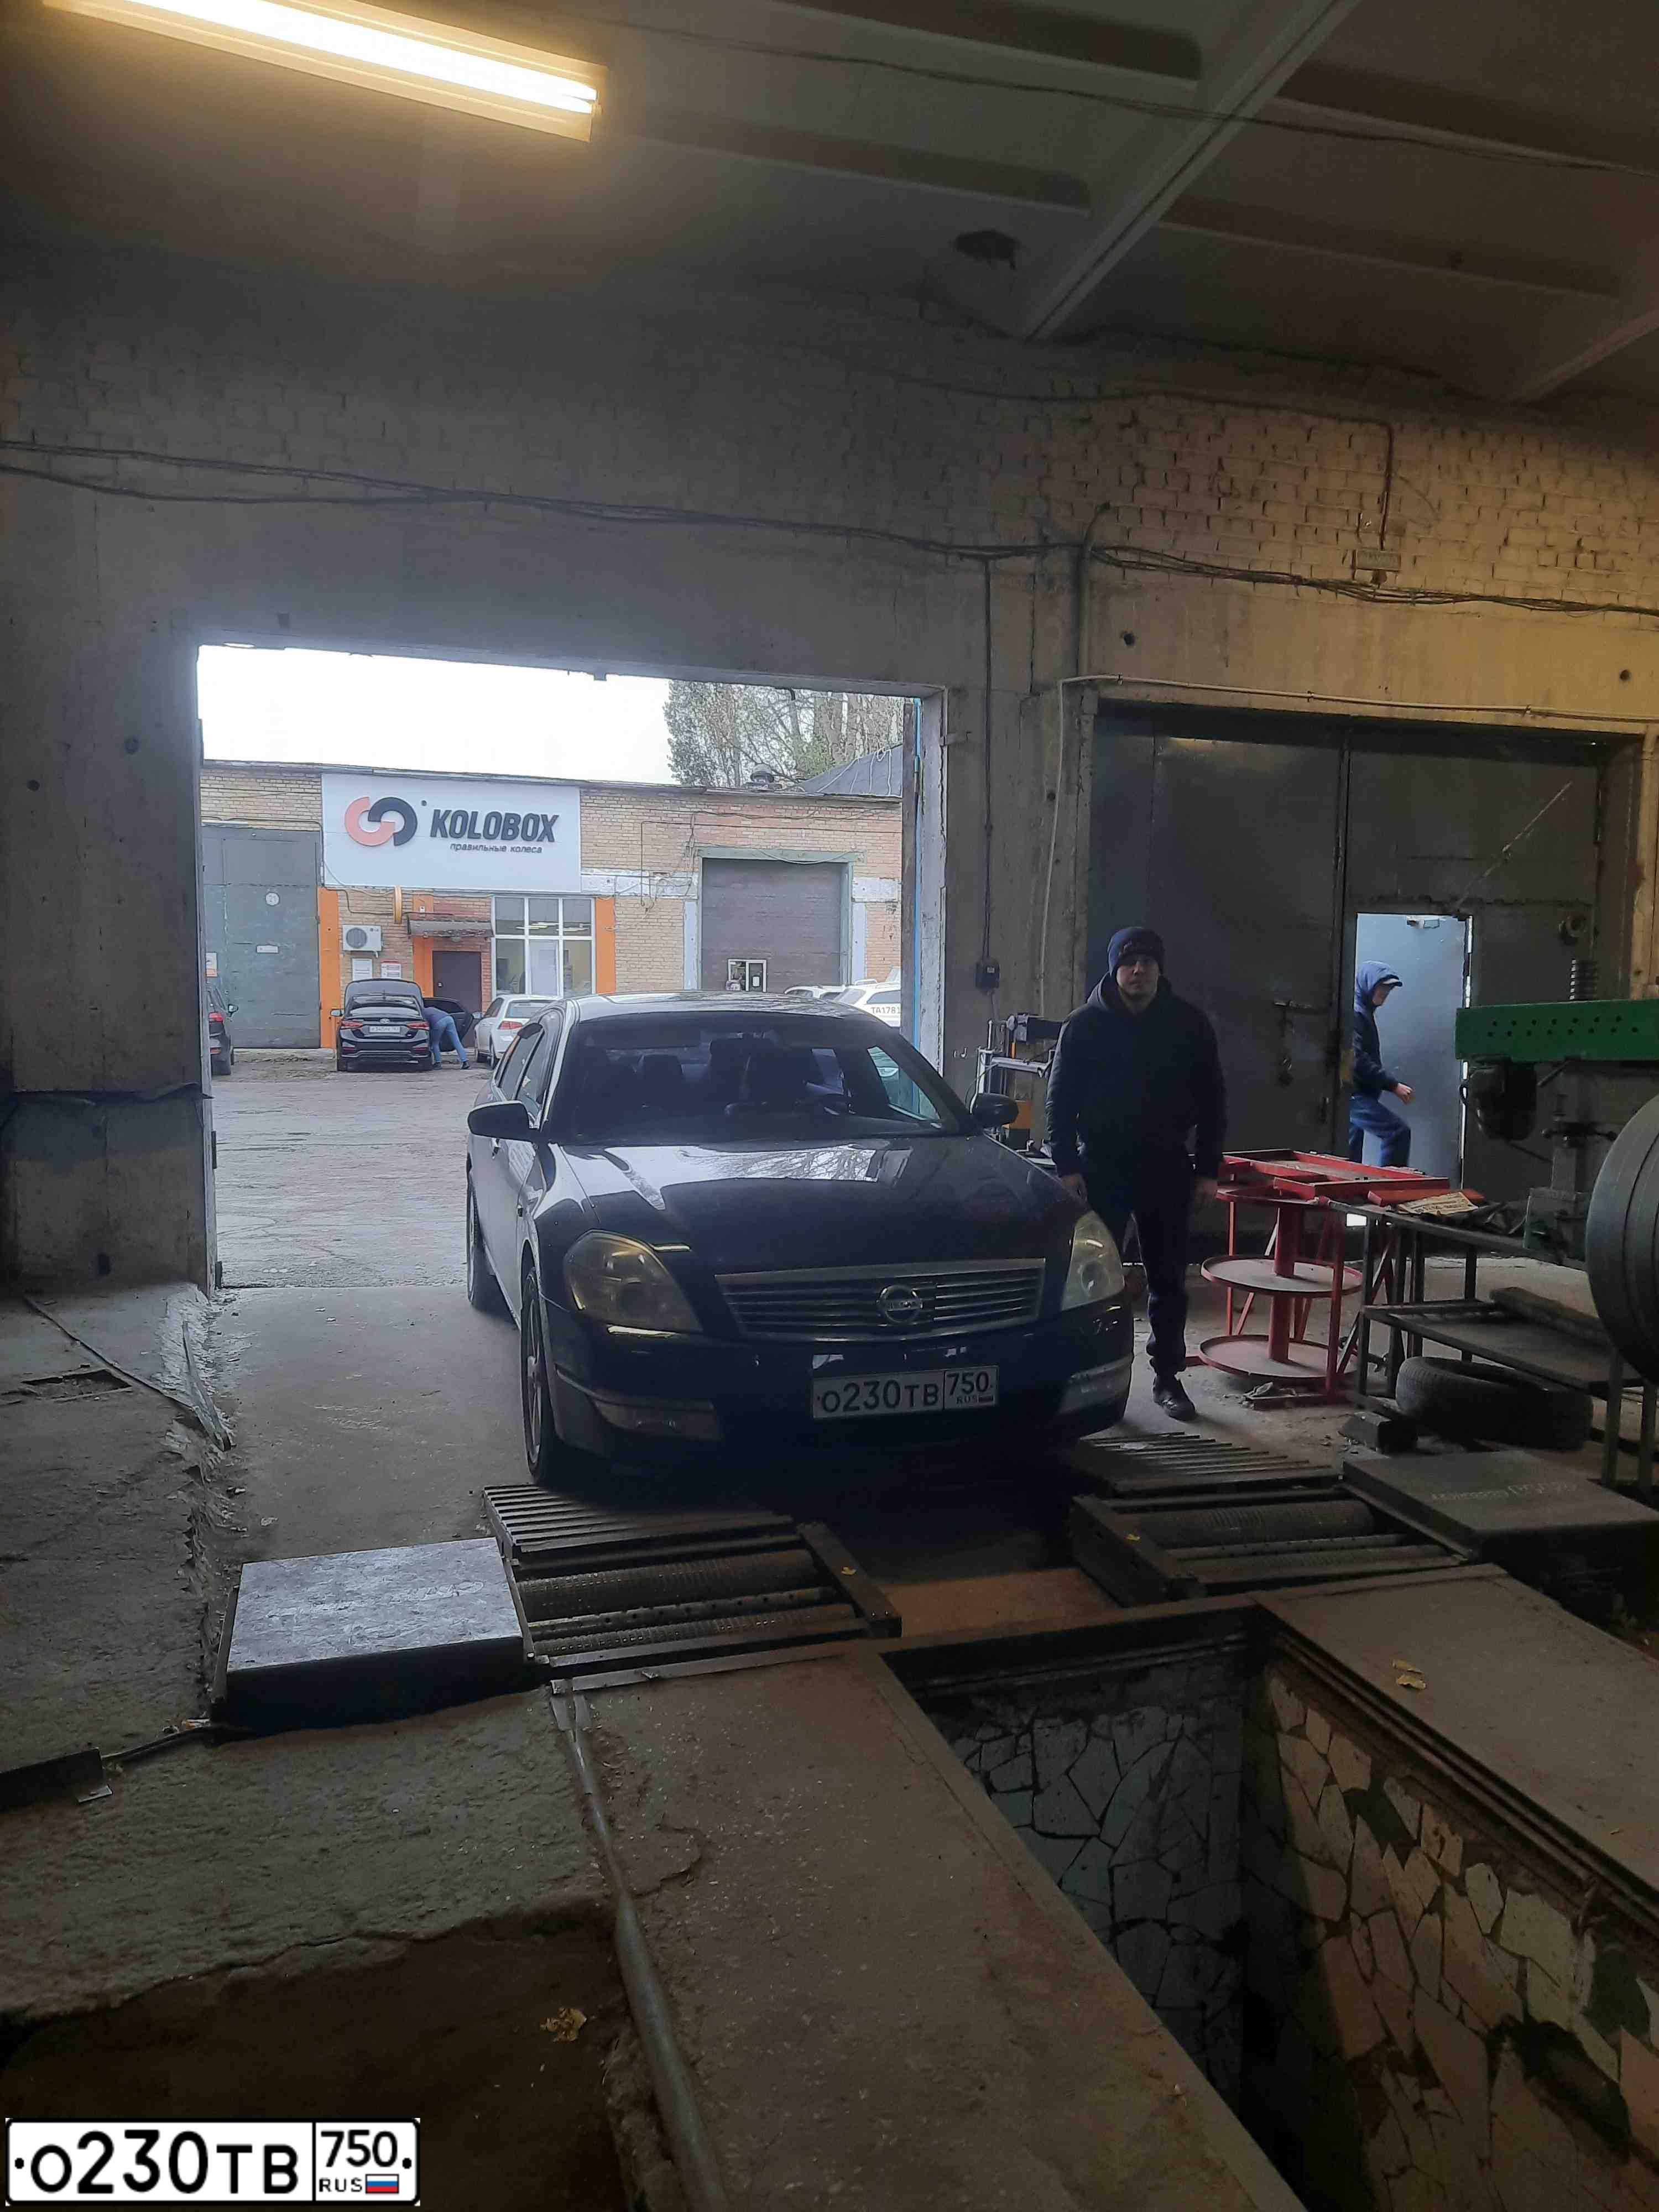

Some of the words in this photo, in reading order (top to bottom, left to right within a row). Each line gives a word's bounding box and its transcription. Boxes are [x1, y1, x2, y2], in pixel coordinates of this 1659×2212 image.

[430, 808, 560, 842] KOLOBOX
[450, 843, 507, 853] правильные
[510, 844, 542, 853] колеса
[946, 1371, 989, 1396] 750
[956, 1395, 978, 1404] RUS
